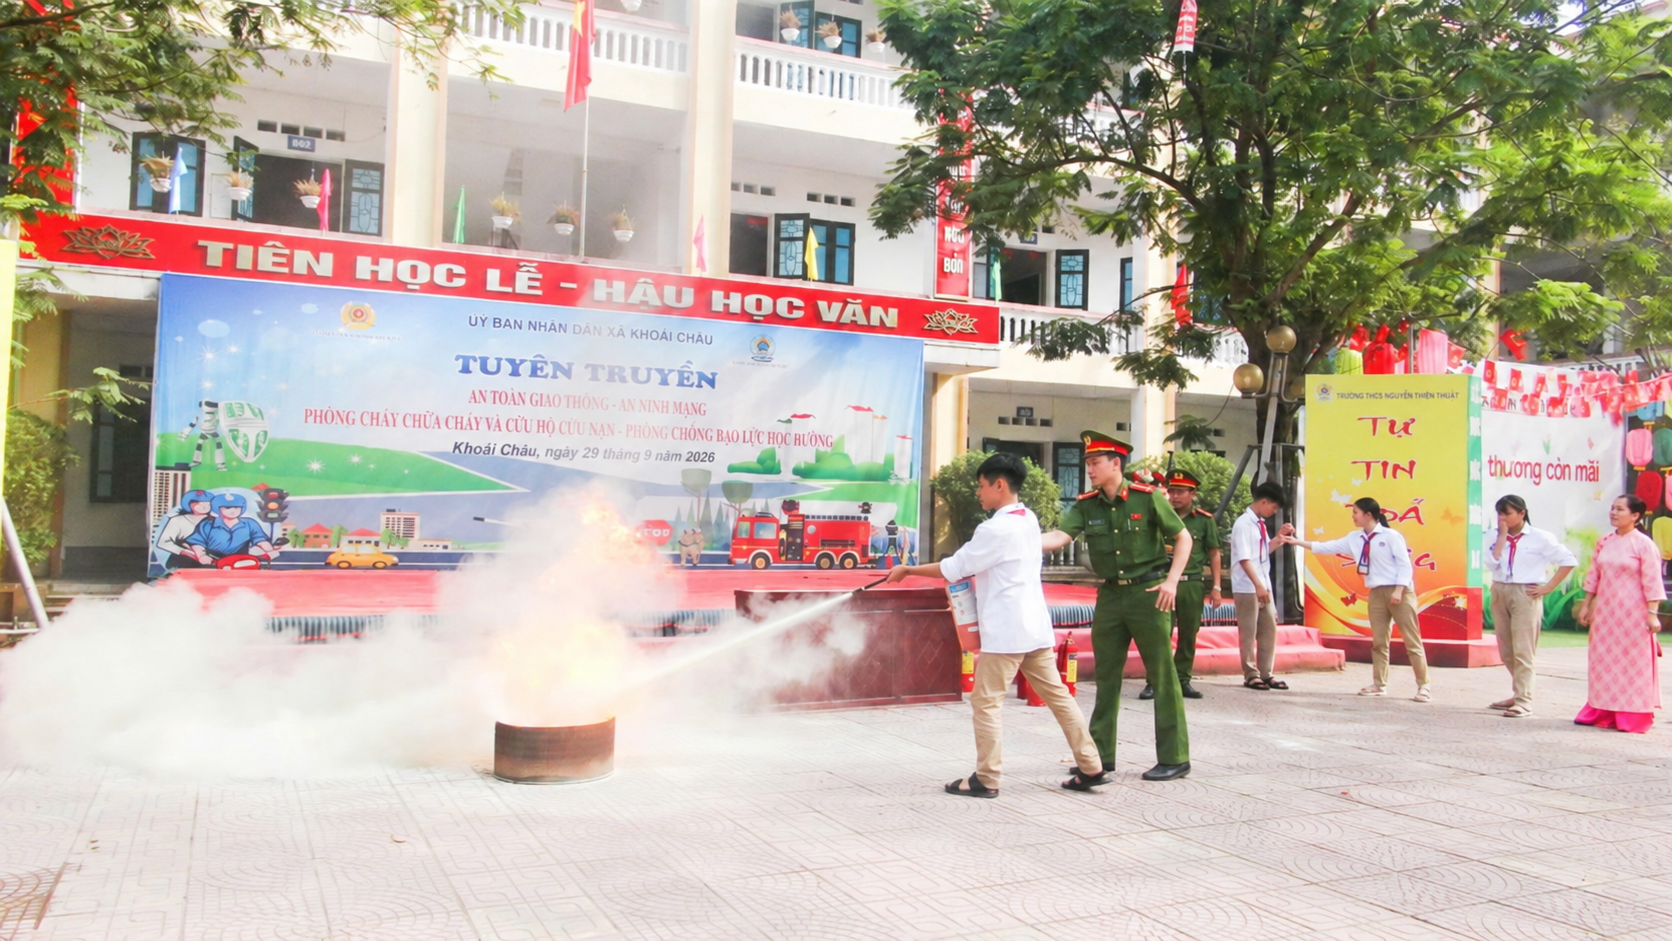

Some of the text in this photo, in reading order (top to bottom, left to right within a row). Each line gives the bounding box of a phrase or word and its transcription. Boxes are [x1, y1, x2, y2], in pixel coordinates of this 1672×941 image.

[197, 239, 899, 328] TIÊN HỌC LỄ - HẬU HỌC VĂN
[493, 316, 523, 331] BAN
[527, 319, 568, 335] NHÂN
[572, 321, 602, 337] DÂN
[630, 328, 672, 342] KHOÁI
[676, 331, 714, 345] CHÂU
[454, 353, 719, 390] TUYÊN TRUYỀN
[468, 389, 488, 404] AN
[490, 387, 527, 406] TOÀN
[529, 391, 562, 408] GIAO
[564, 392, 610, 411] THÔNG
[618, 398, 636, 412] AN
[638, 398, 670, 414] NINH
[672, 401, 708, 418] MẠNG
[1365, 391, 1384, 400] THCS
[1384, 389, 1413, 400] NGUYỄN
[303, 406, 356, 427] PHÒNG
[359, 408, 401, 428] CHÁY
[402, 410, 442, 430] CHỮA
[444, 412, 483, 431] CHÁY
[485, 413, 502, 432] VÀ
[536, 416, 556, 438] HỘ
[589, 422, 616, 440] NẠN
[625, 421, 669, 440] PHÒNG
[671, 421, 713, 442] CHỐNG
[716, 428, 740, 446] BẠO
[767, 431, 792, 449] HỌC
[452, 441, 716, 463] Khoái Châu, ngày 29 tháng 9 năm 2026
[1351, 459, 1417, 481] TIN
[1487, 454, 1599, 486] thương còn mãi
